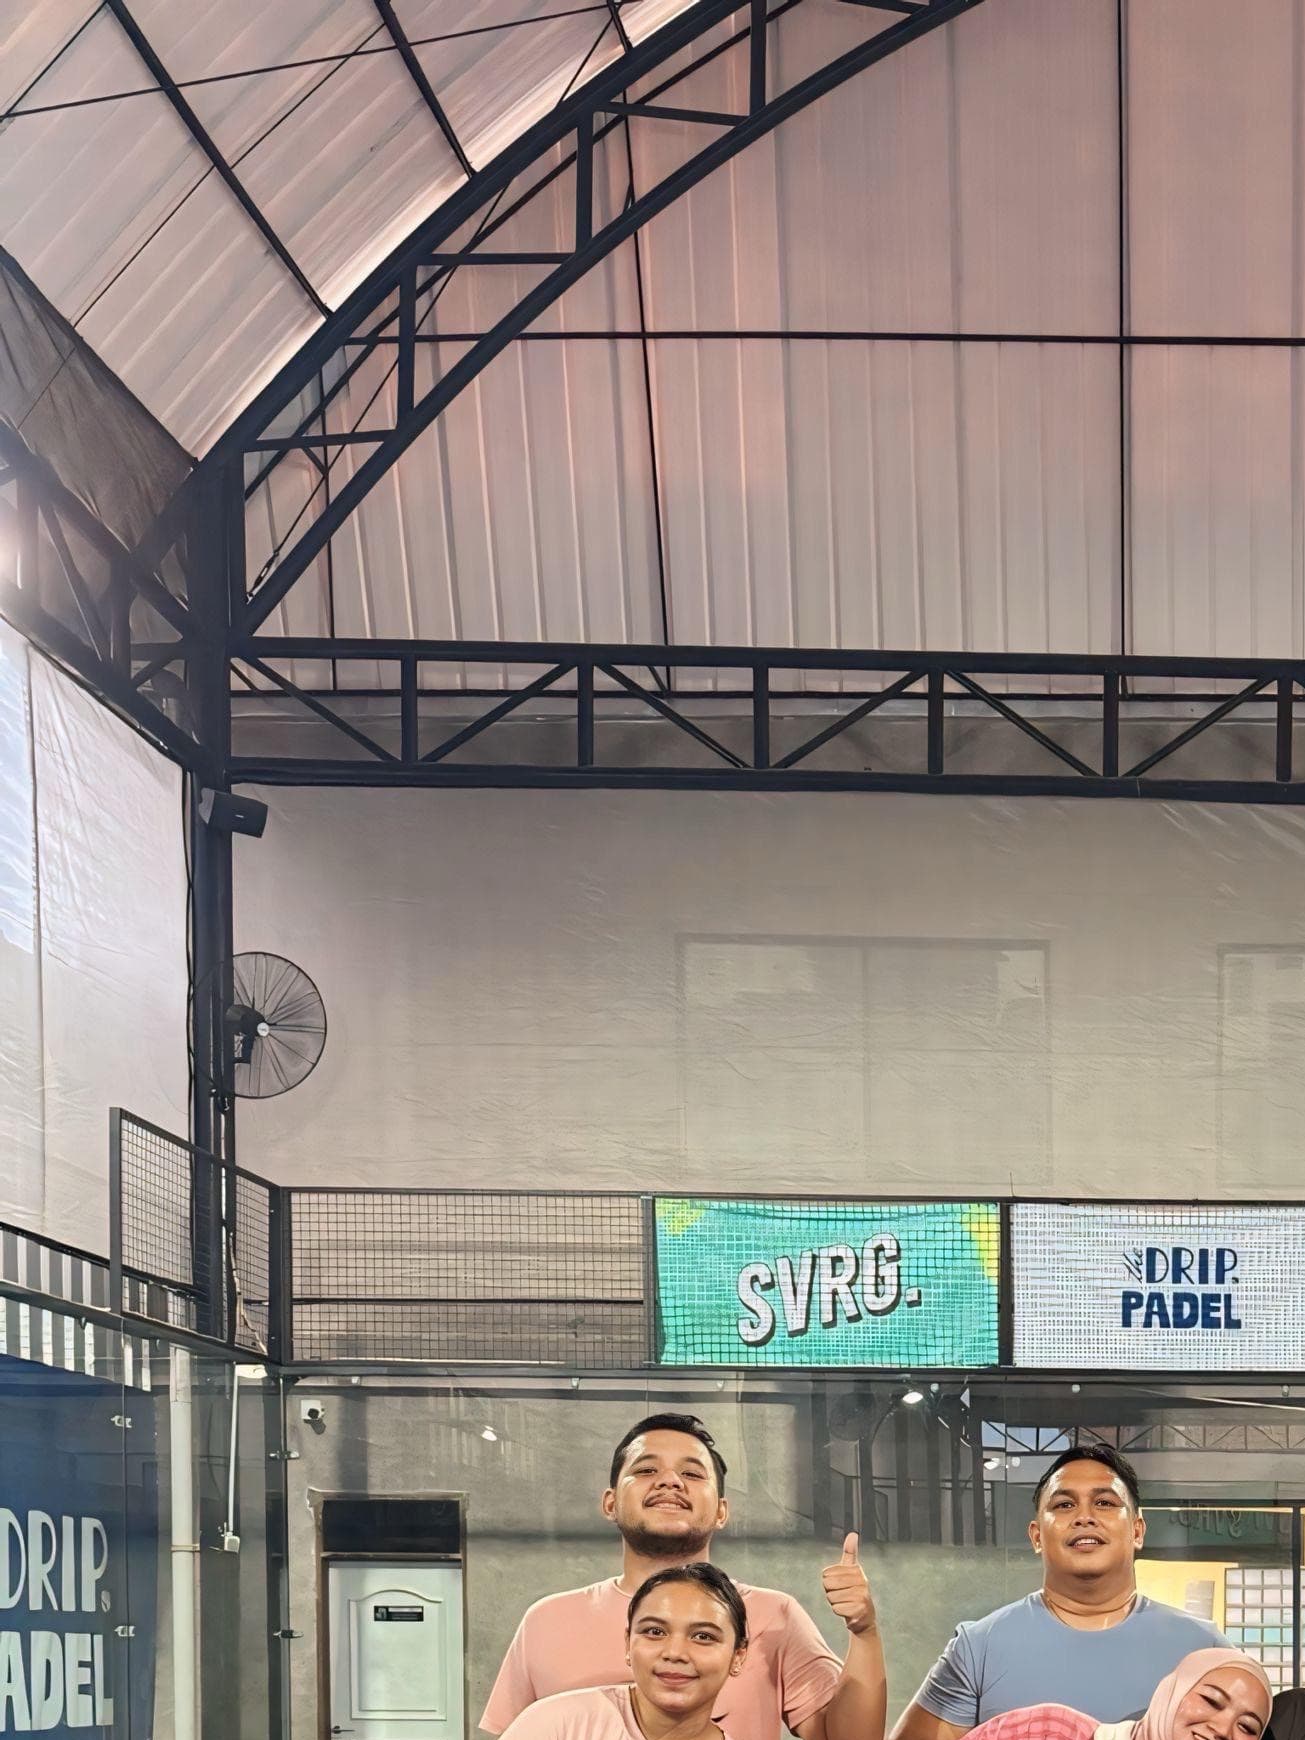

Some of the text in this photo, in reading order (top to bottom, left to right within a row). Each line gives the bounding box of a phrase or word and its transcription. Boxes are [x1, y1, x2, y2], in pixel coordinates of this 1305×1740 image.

[737, 1232, 922, 1347] SVRG.
[1121, 1290, 1242, 1329] PADEL
[0, 1630, 114, 1731] ADEL
